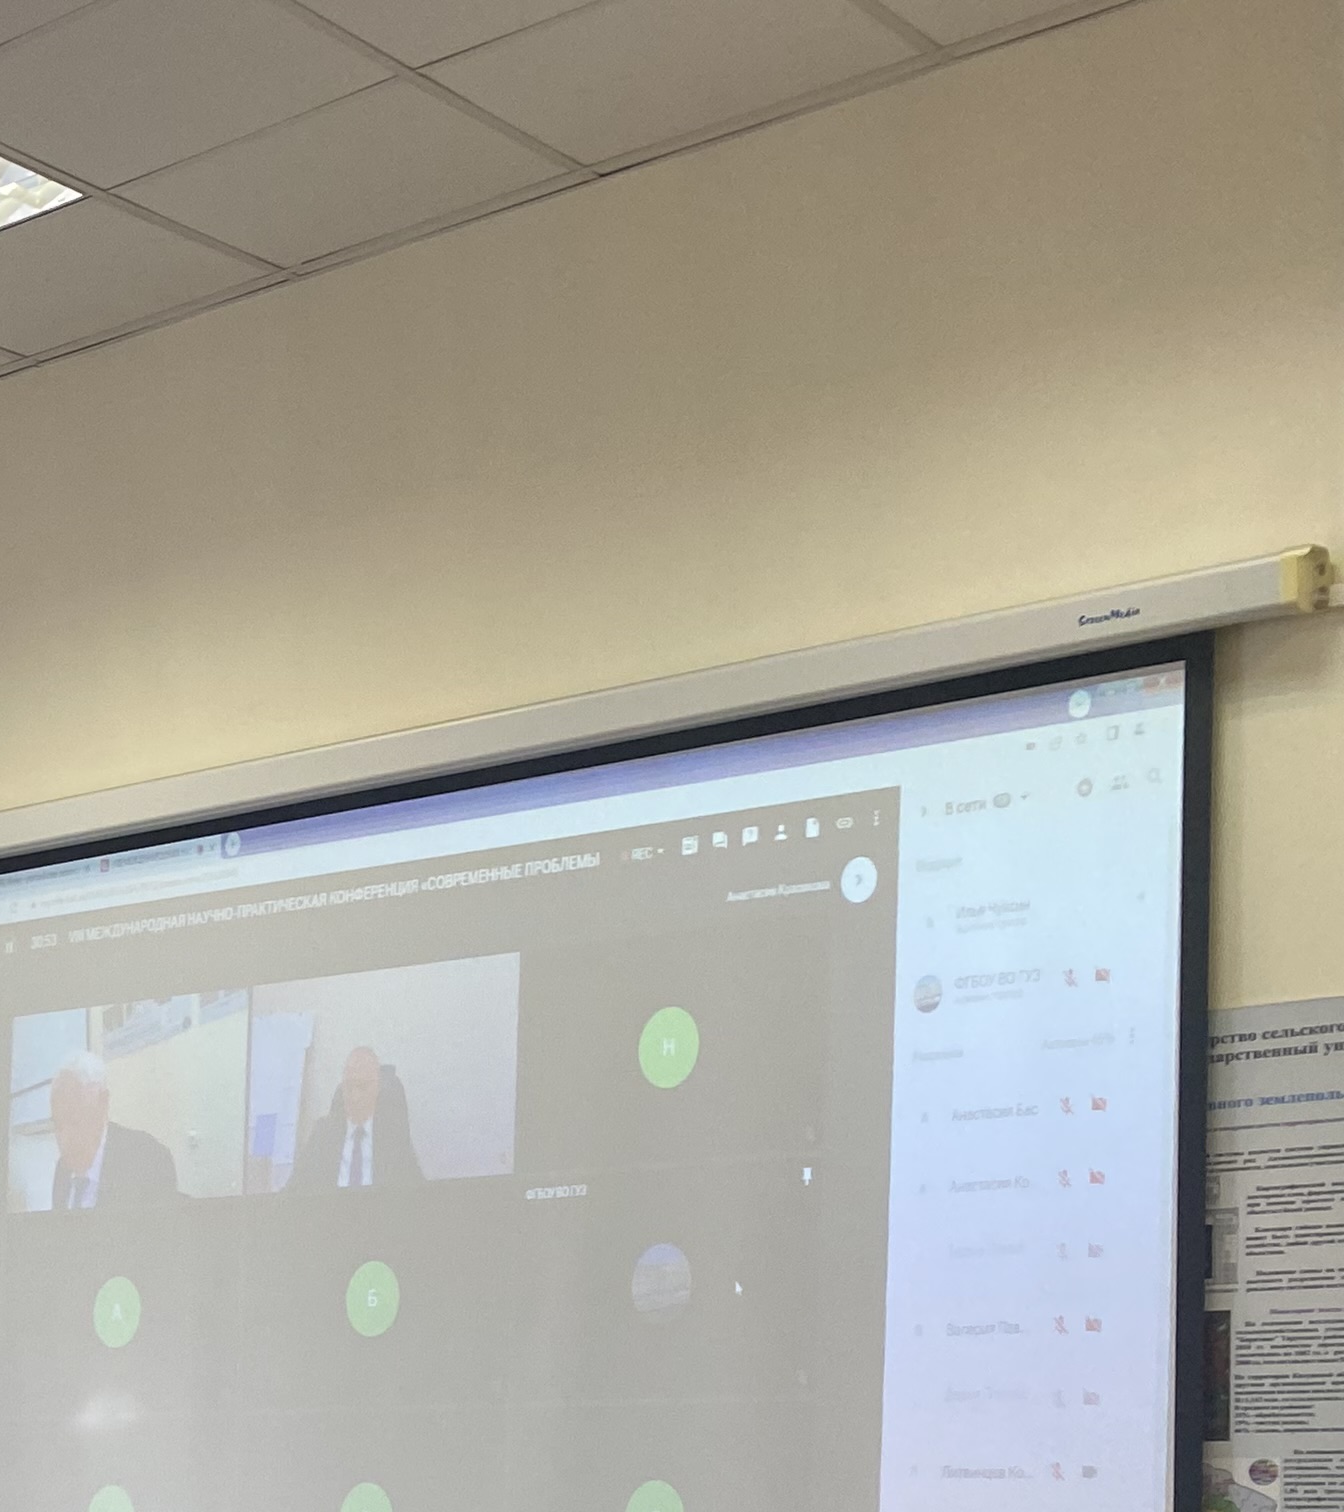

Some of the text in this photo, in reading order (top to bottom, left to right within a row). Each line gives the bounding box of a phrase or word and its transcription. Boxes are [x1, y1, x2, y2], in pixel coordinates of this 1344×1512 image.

[86, 915, 187, 943] МЕЖДУНАРОДНАЯ
[329, 878, 419, 907] КОНФЕРЕНЦИЯ
[524, 851, 601, 877] ПРОБЛЕМЫ
